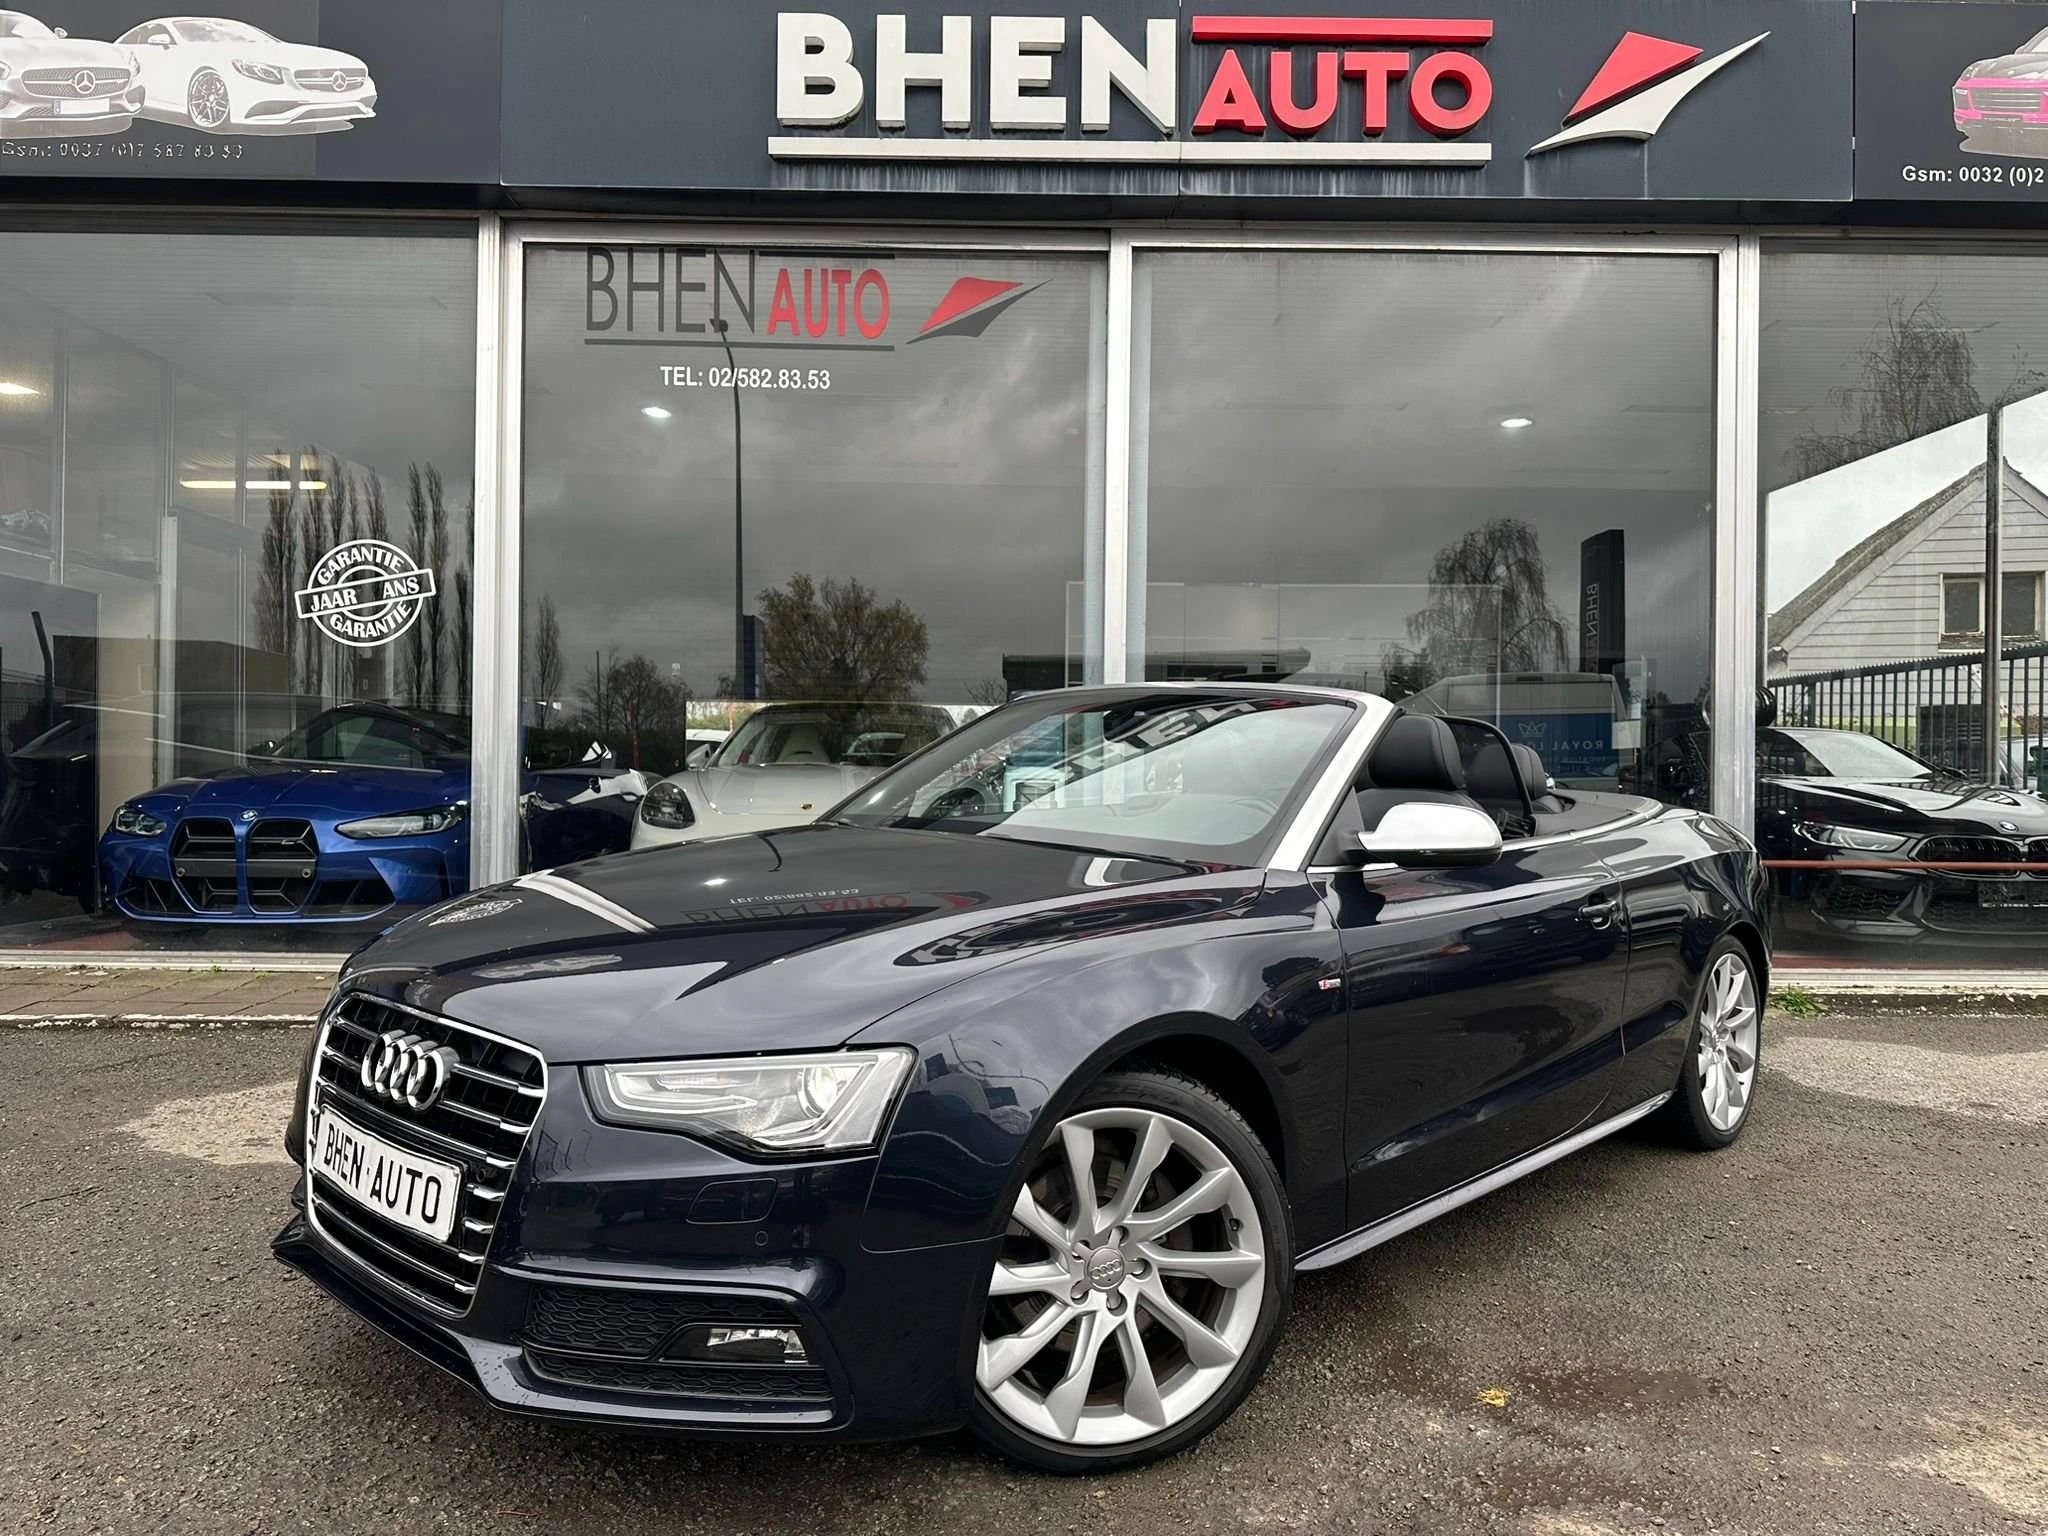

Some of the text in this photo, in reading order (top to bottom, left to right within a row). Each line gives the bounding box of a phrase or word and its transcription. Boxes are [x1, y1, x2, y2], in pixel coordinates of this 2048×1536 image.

[776, 12, 1492, 137] BHEN AUTO
[1902, 165, 2045, 187] Gsm: 0032 (0)2
[586, 247, 890, 339] BHEN AUTO
[660, 366, 831, 389] TEL: 02/582.83.53
[317, 546, 405, 585] GARANTIE
[311, 577, 420, 612] JAAR ANS
[330, 599, 412, 638] GARANTIE
